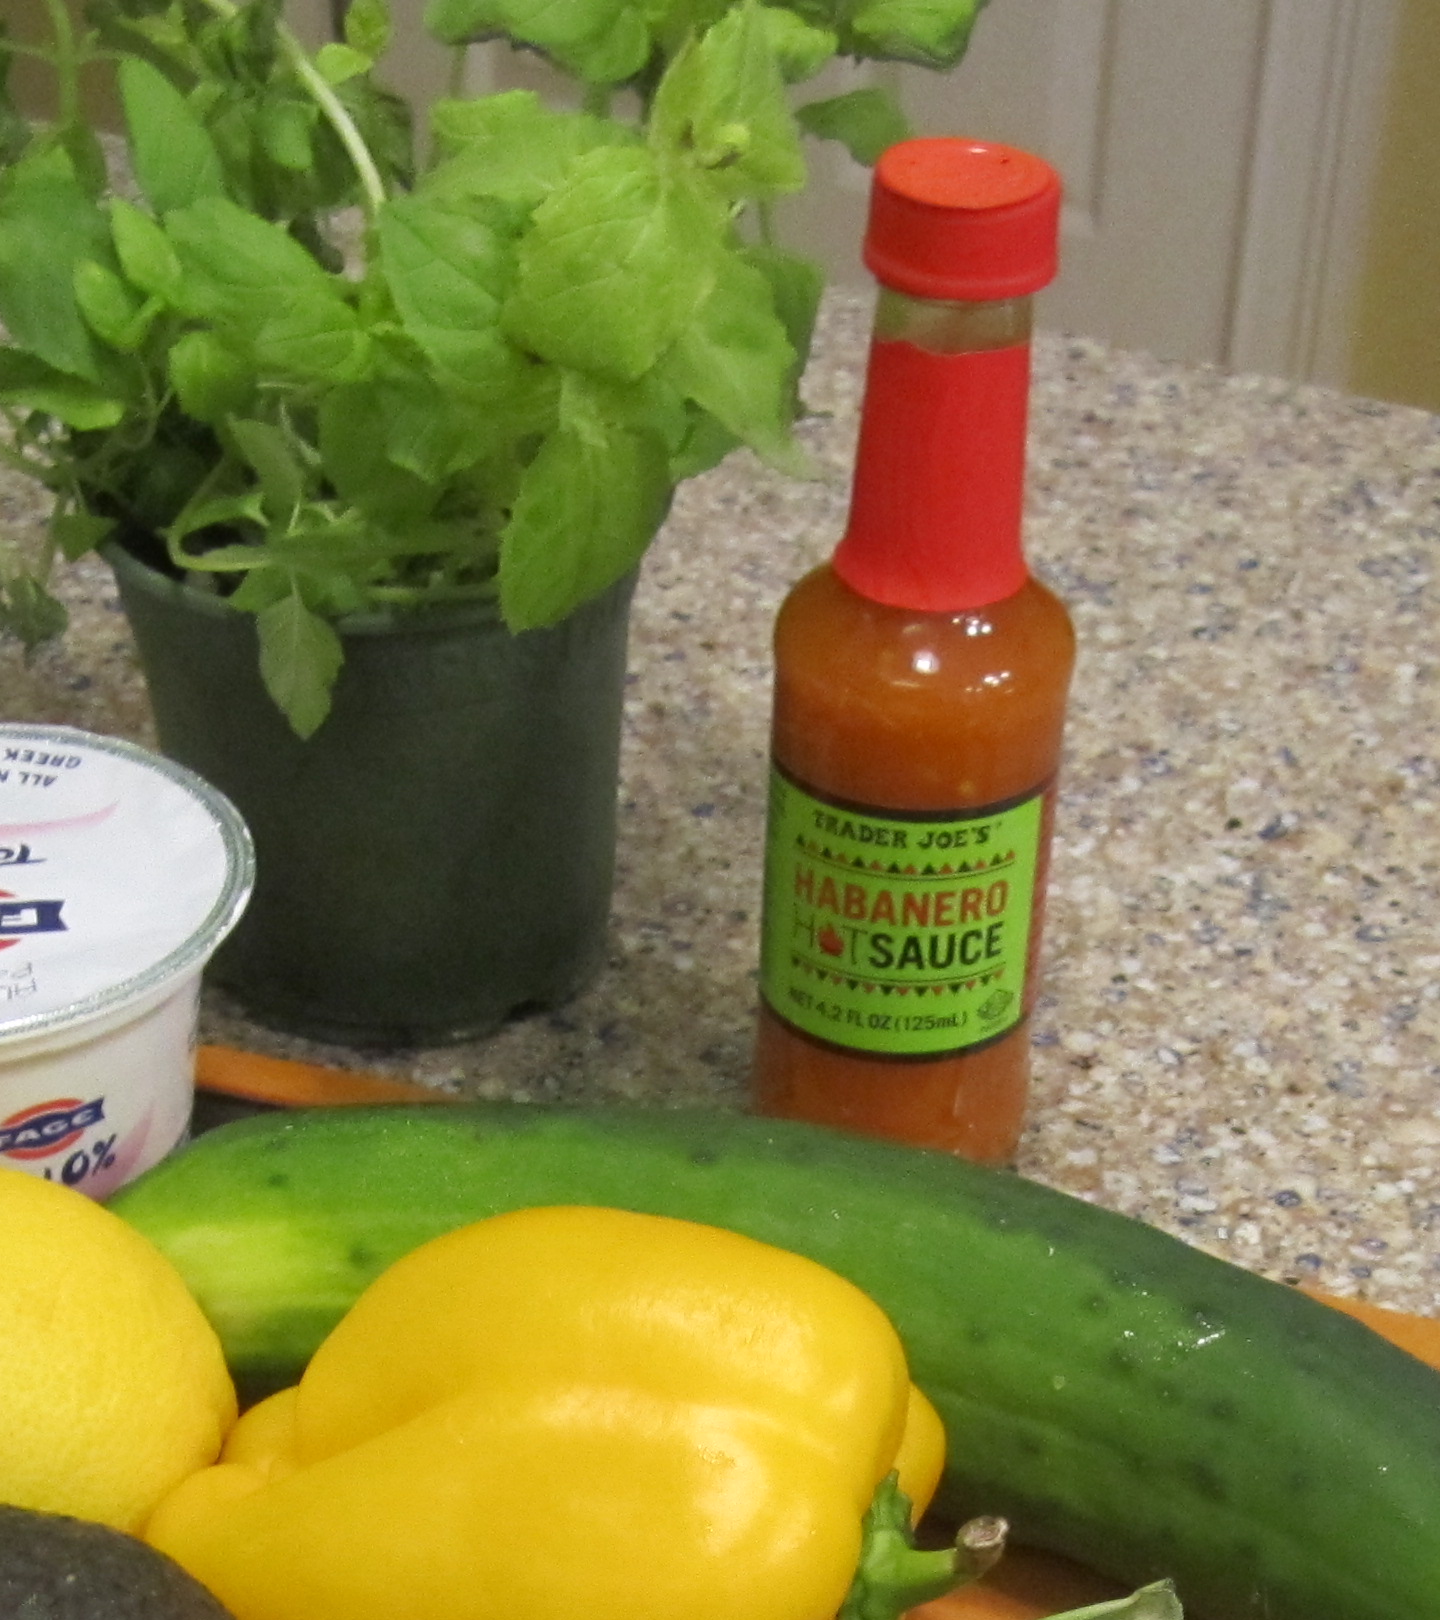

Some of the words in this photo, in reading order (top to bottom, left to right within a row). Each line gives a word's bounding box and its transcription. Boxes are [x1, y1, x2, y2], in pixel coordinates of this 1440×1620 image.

[5, 748, 83, 769] GREEK
[19, 770, 58, 788] ALL
[812, 809, 907, 849] TRADER
[793, 862, 1009, 927] HABANERO
[870, 920, 1005, 970] SAUCE
[61, 1134, 117, 1185] 0%
